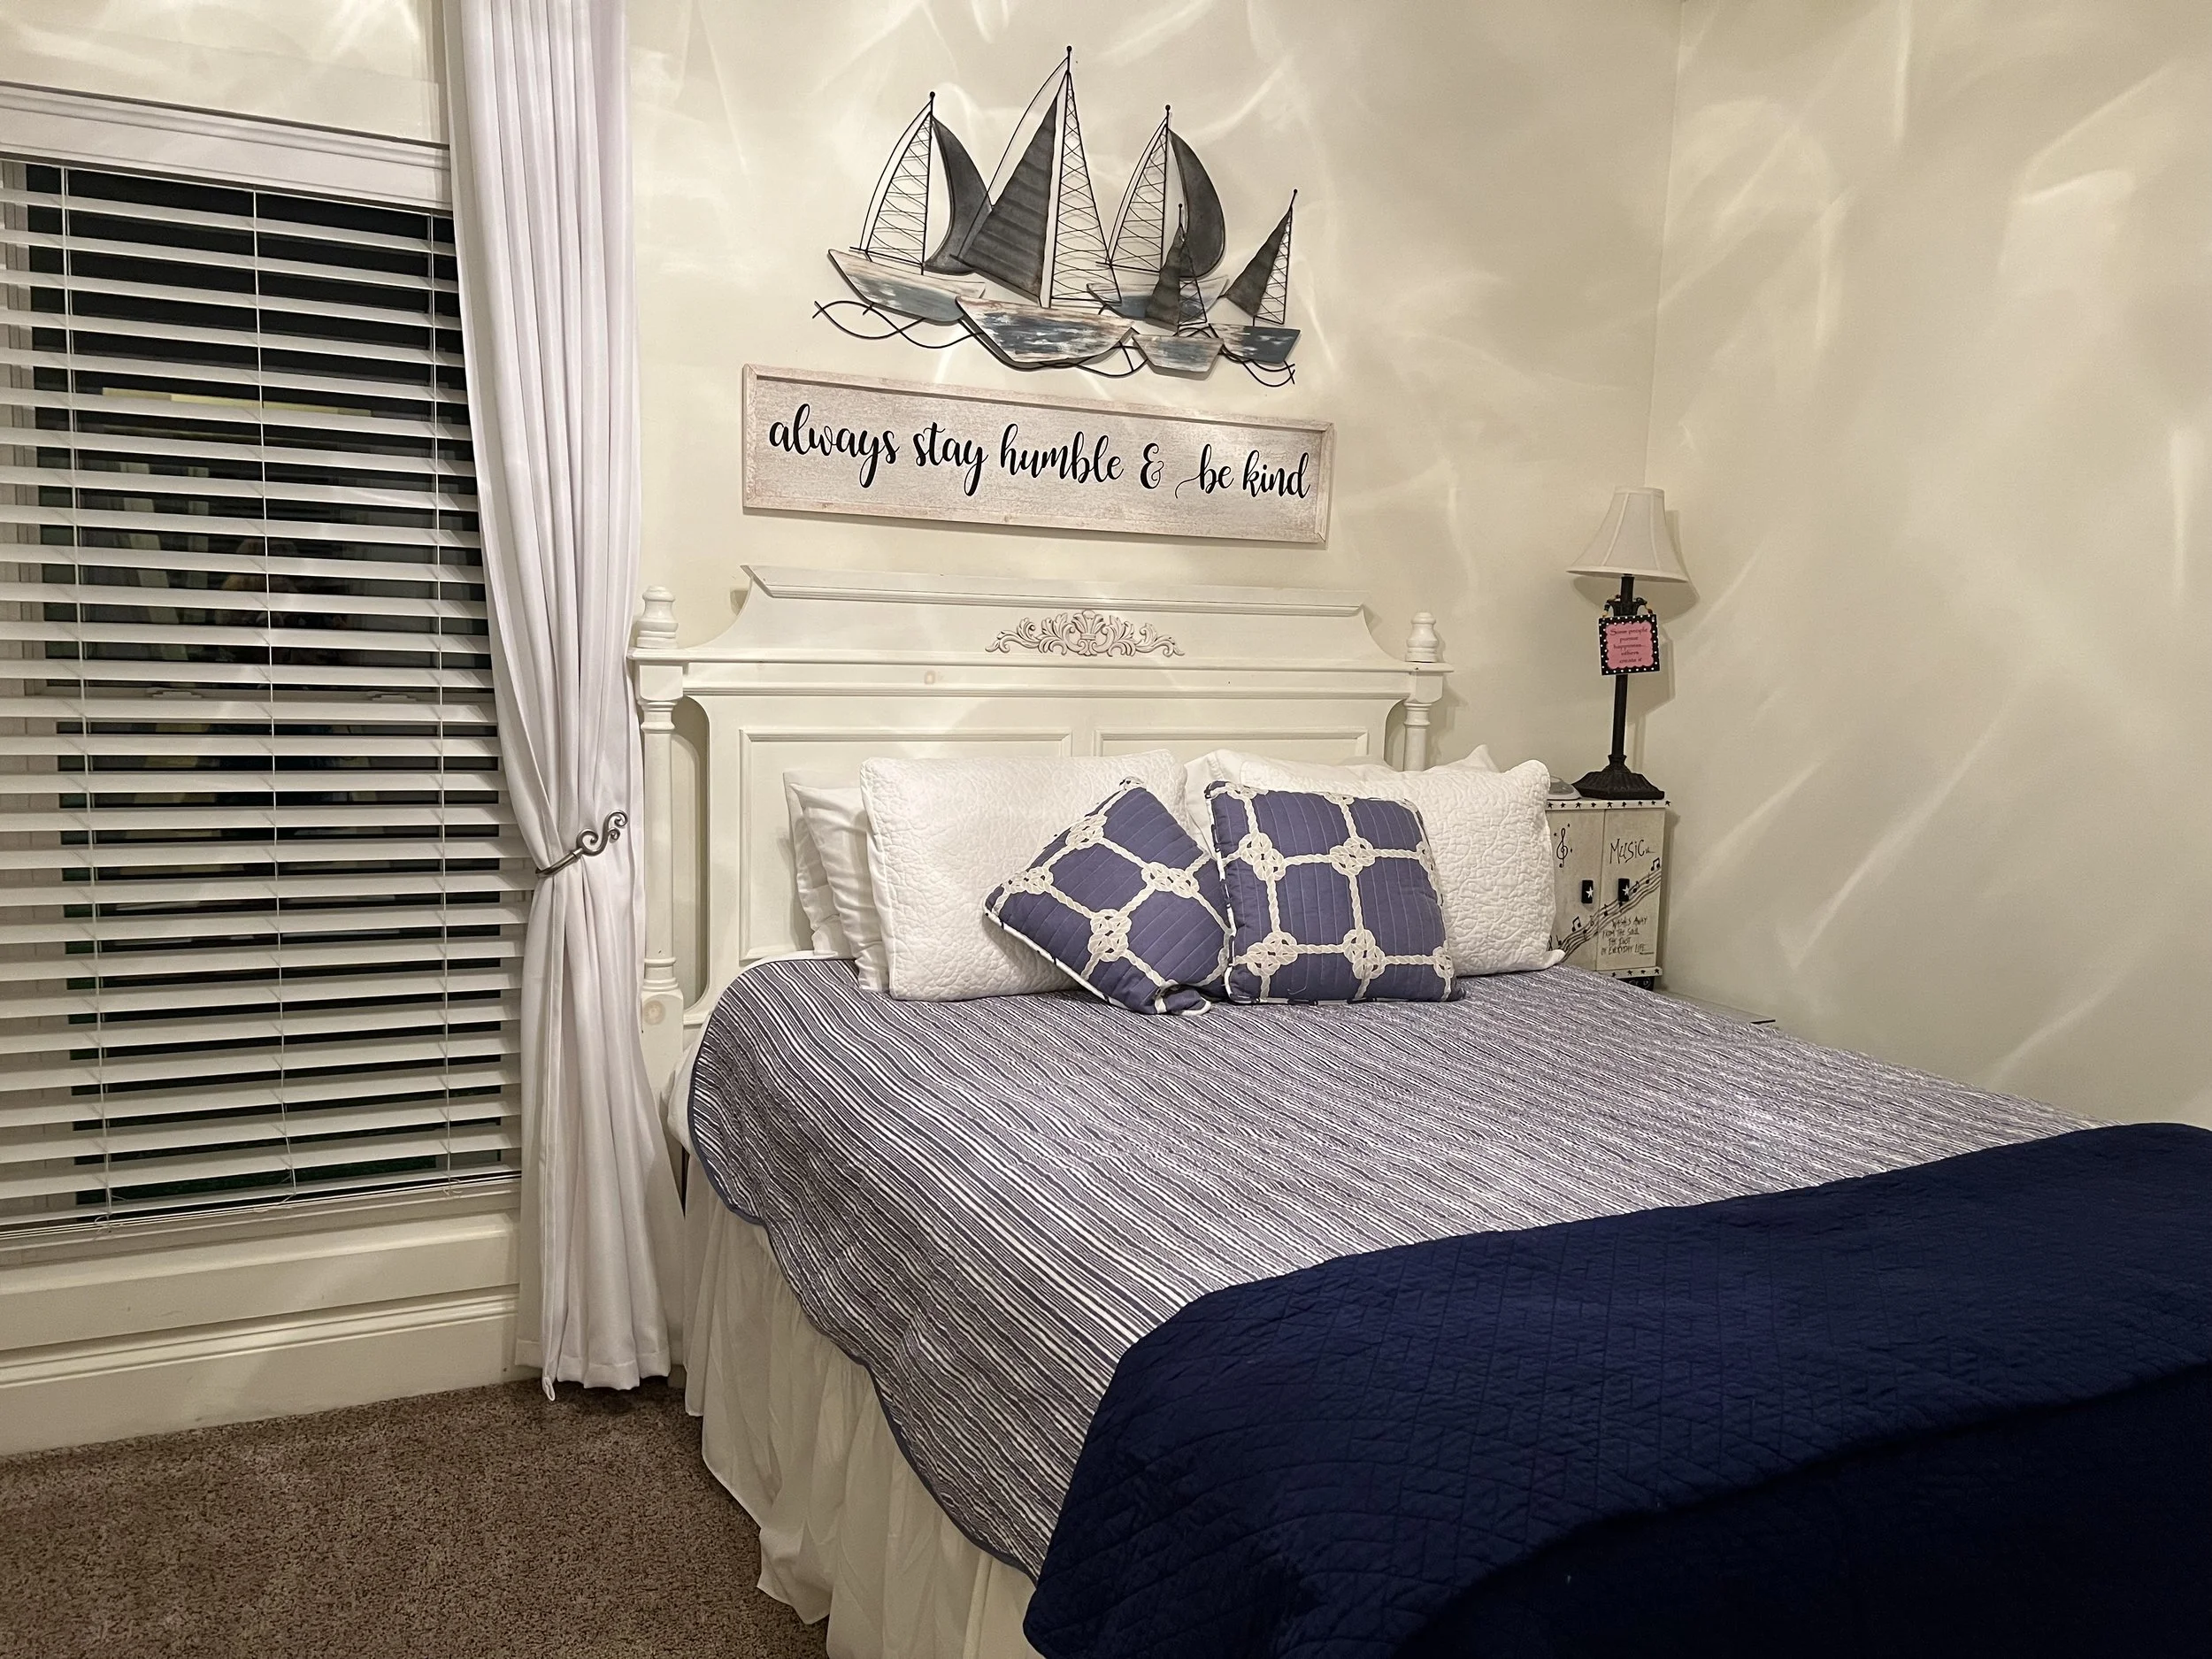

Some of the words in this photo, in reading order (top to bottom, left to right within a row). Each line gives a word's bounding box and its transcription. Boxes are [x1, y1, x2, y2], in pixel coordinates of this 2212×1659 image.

[769, 403, 901, 488] always
[912, 421, 989, 497] stay
[1000, 423, 1125, 484] humble
[1140, 442, 1164, 489] &
[1174, 443, 1234, 499] be
[1242, 449, 1311, 499] kind
